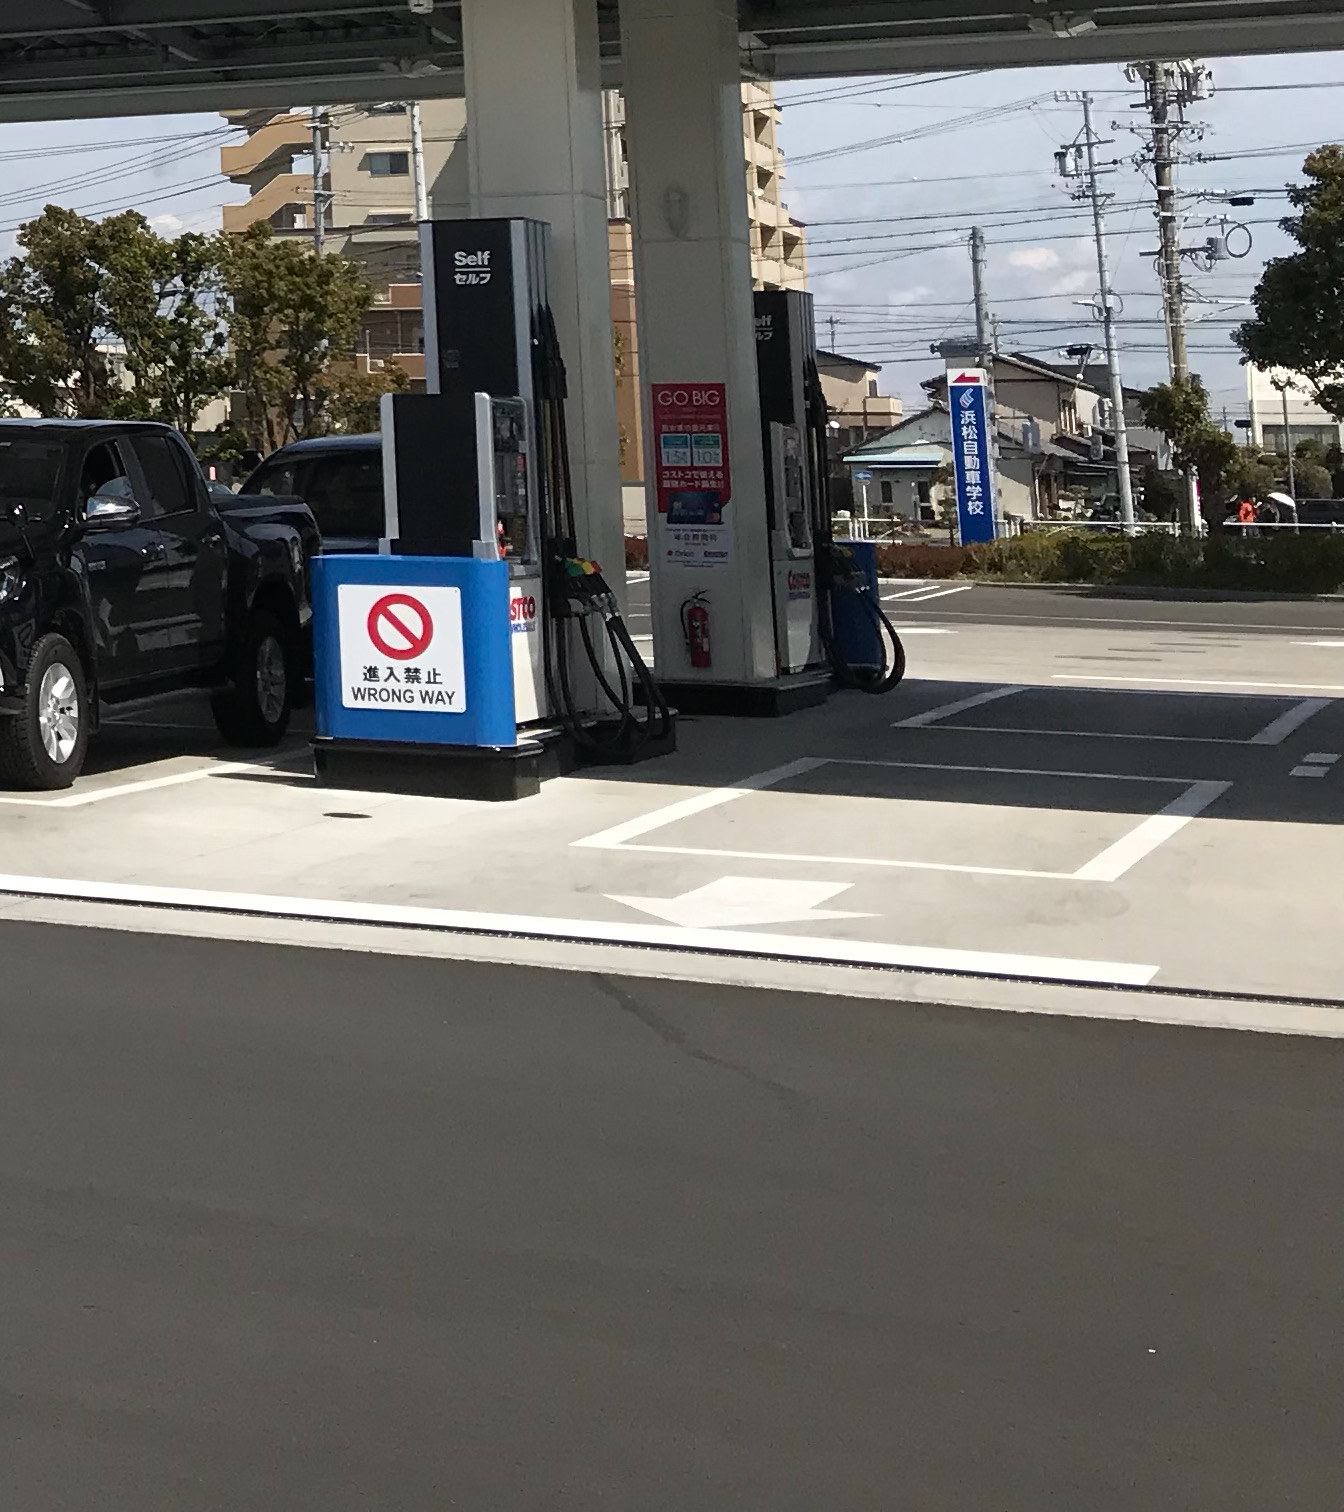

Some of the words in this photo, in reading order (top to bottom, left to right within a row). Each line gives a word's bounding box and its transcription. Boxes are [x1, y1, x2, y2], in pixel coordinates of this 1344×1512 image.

[454, 251, 490, 266] Self
[454, 273, 491, 285] セルフ
[658, 390, 689, 406] GO
[692, 390, 720, 406] BIG
[960, 410, 984, 515] 浜松自動車学校
[510, 596, 535, 621] STCO
[363, 665, 443, 685] 進入禁止
[351, 686, 415, 704] WRONG
[419, 689, 456, 705] WAY
